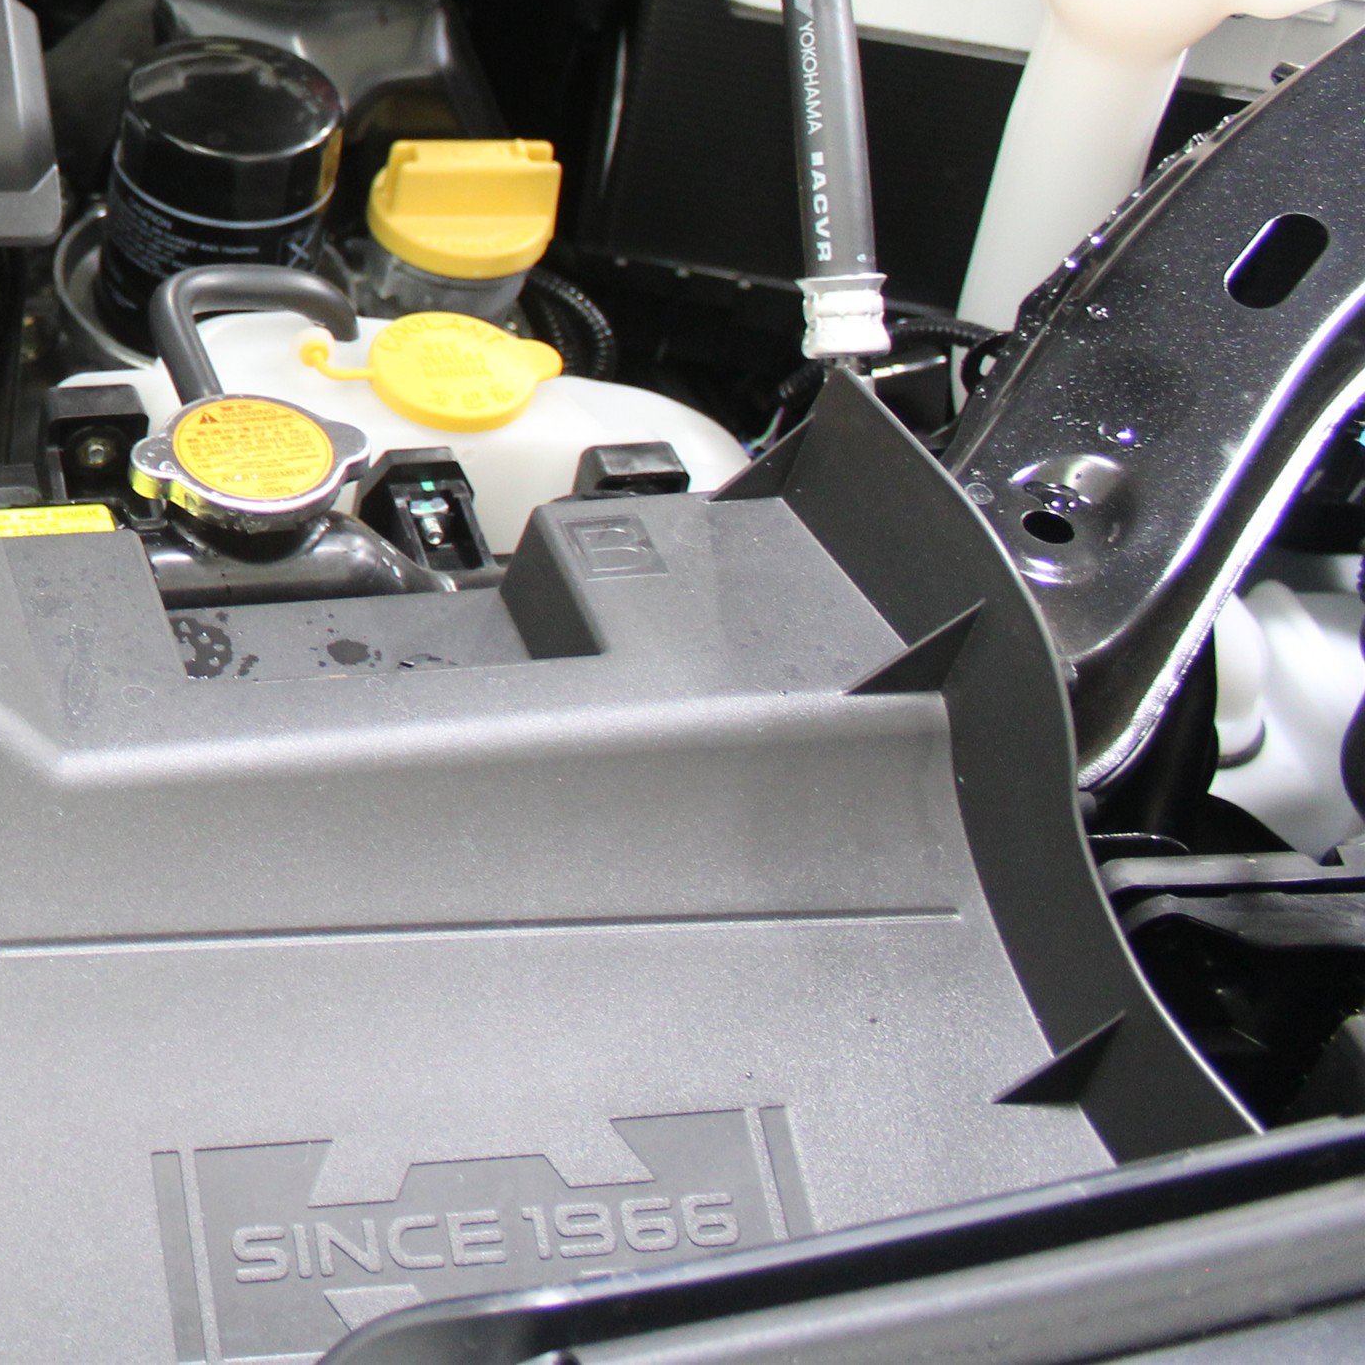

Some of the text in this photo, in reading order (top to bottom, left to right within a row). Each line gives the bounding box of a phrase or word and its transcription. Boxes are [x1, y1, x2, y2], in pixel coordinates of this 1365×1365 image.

[798, 21, 833, 262] YOKOHAMA ACVR
[379, 316, 506, 349] COOLANT
[571, 526, 651, 573] B
[230, 1192, 741, 1283] SINCE 1966
